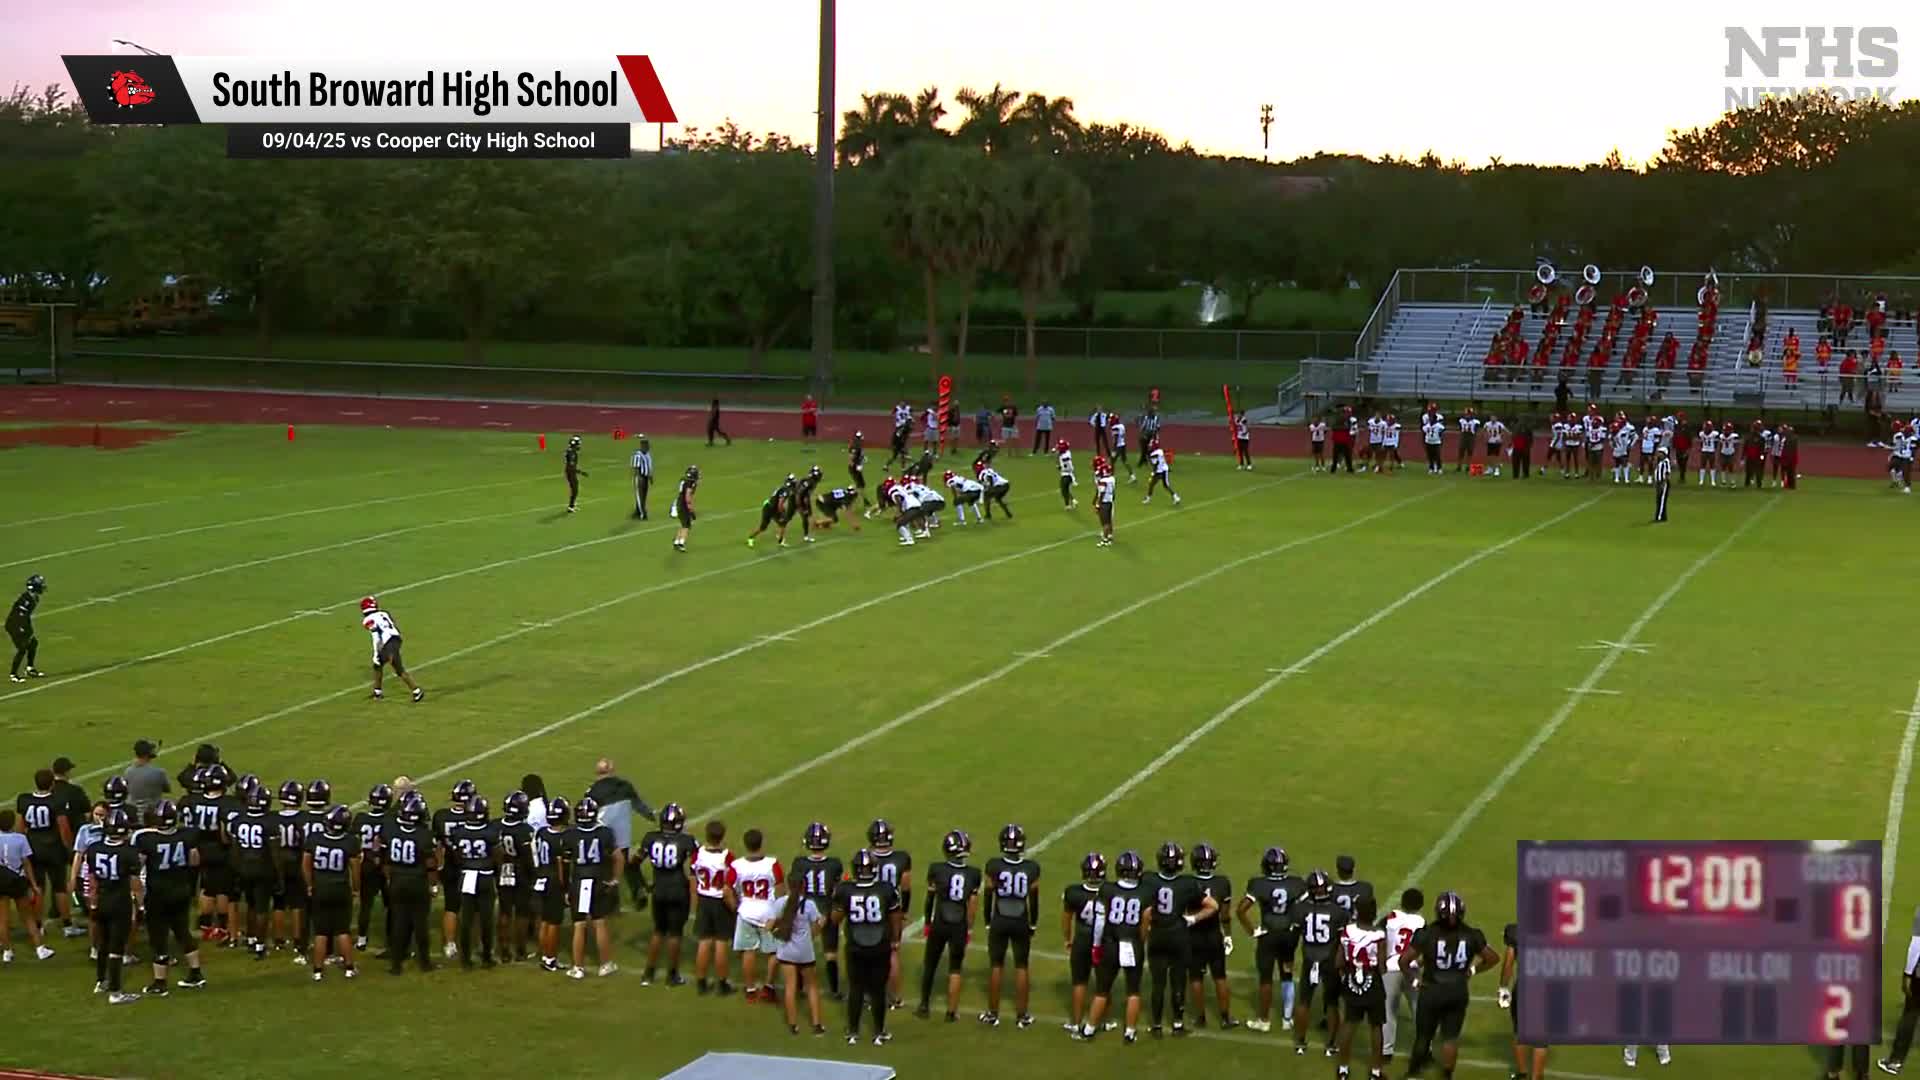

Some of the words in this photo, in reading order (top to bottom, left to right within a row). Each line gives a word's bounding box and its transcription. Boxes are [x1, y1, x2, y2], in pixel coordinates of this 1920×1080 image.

[25, 805, 49, 828] 40
[196, 804, 218, 830] 77
[237, 823, 263, 848] 96
[157, 841, 187, 870] 74
[314, 845, 344, 871] 50
[391, 837, 416, 863] 60
[577, 838, 600, 864] 14
[651, 842, 677, 868] 98
[95, 853, 120, 880] 51
[805, 870, 826, 896] 11
[950, 874, 965, 900] 8
[998, 871, 1027, 898] 30
[850, 896, 882, 922] 58
[1109, 896, 1141, 925] 88
[1158, 887, 1173, 914] 9
[1272, 888, 1287, 914] 3
[1305, 913, 1330, 943] 15
[1436, 940, 1468, 969] 54
